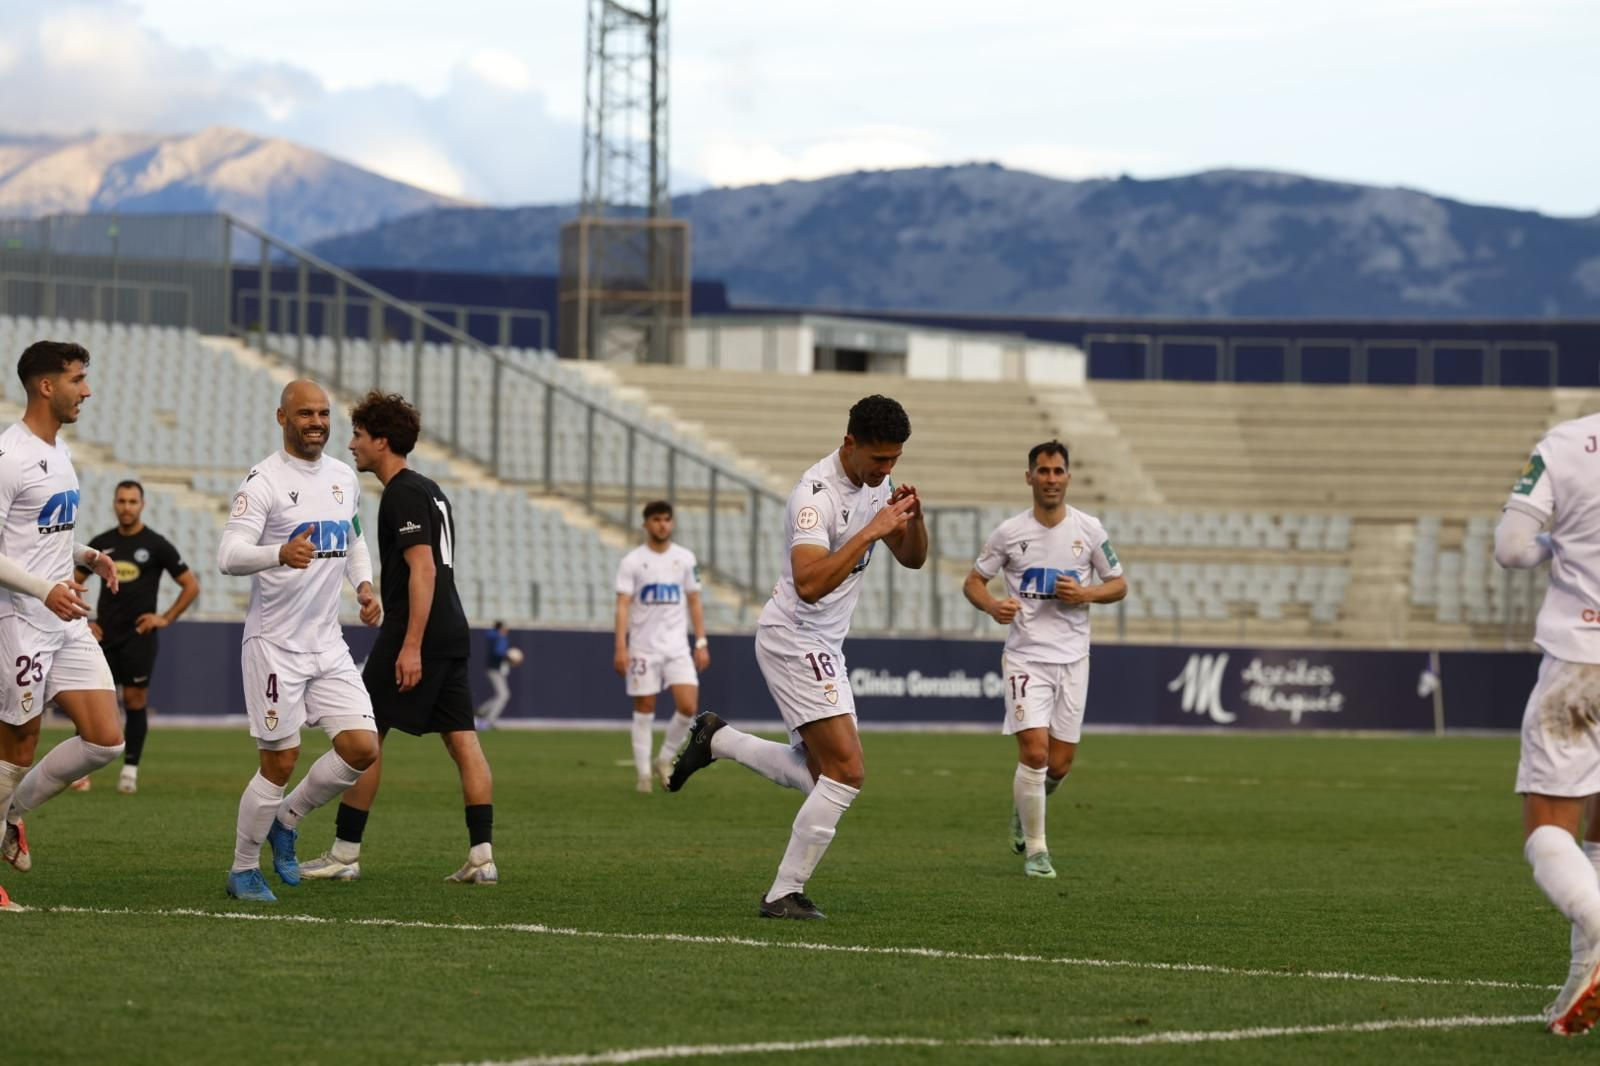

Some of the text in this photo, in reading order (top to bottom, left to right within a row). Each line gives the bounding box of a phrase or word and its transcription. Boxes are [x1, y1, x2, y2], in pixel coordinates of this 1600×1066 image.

[16, 653, 43, 687] 25
[631, 658, 646, 675] 23
[266, 673, 279, 703] 4
[1009, 675, 1029, 700] 17
